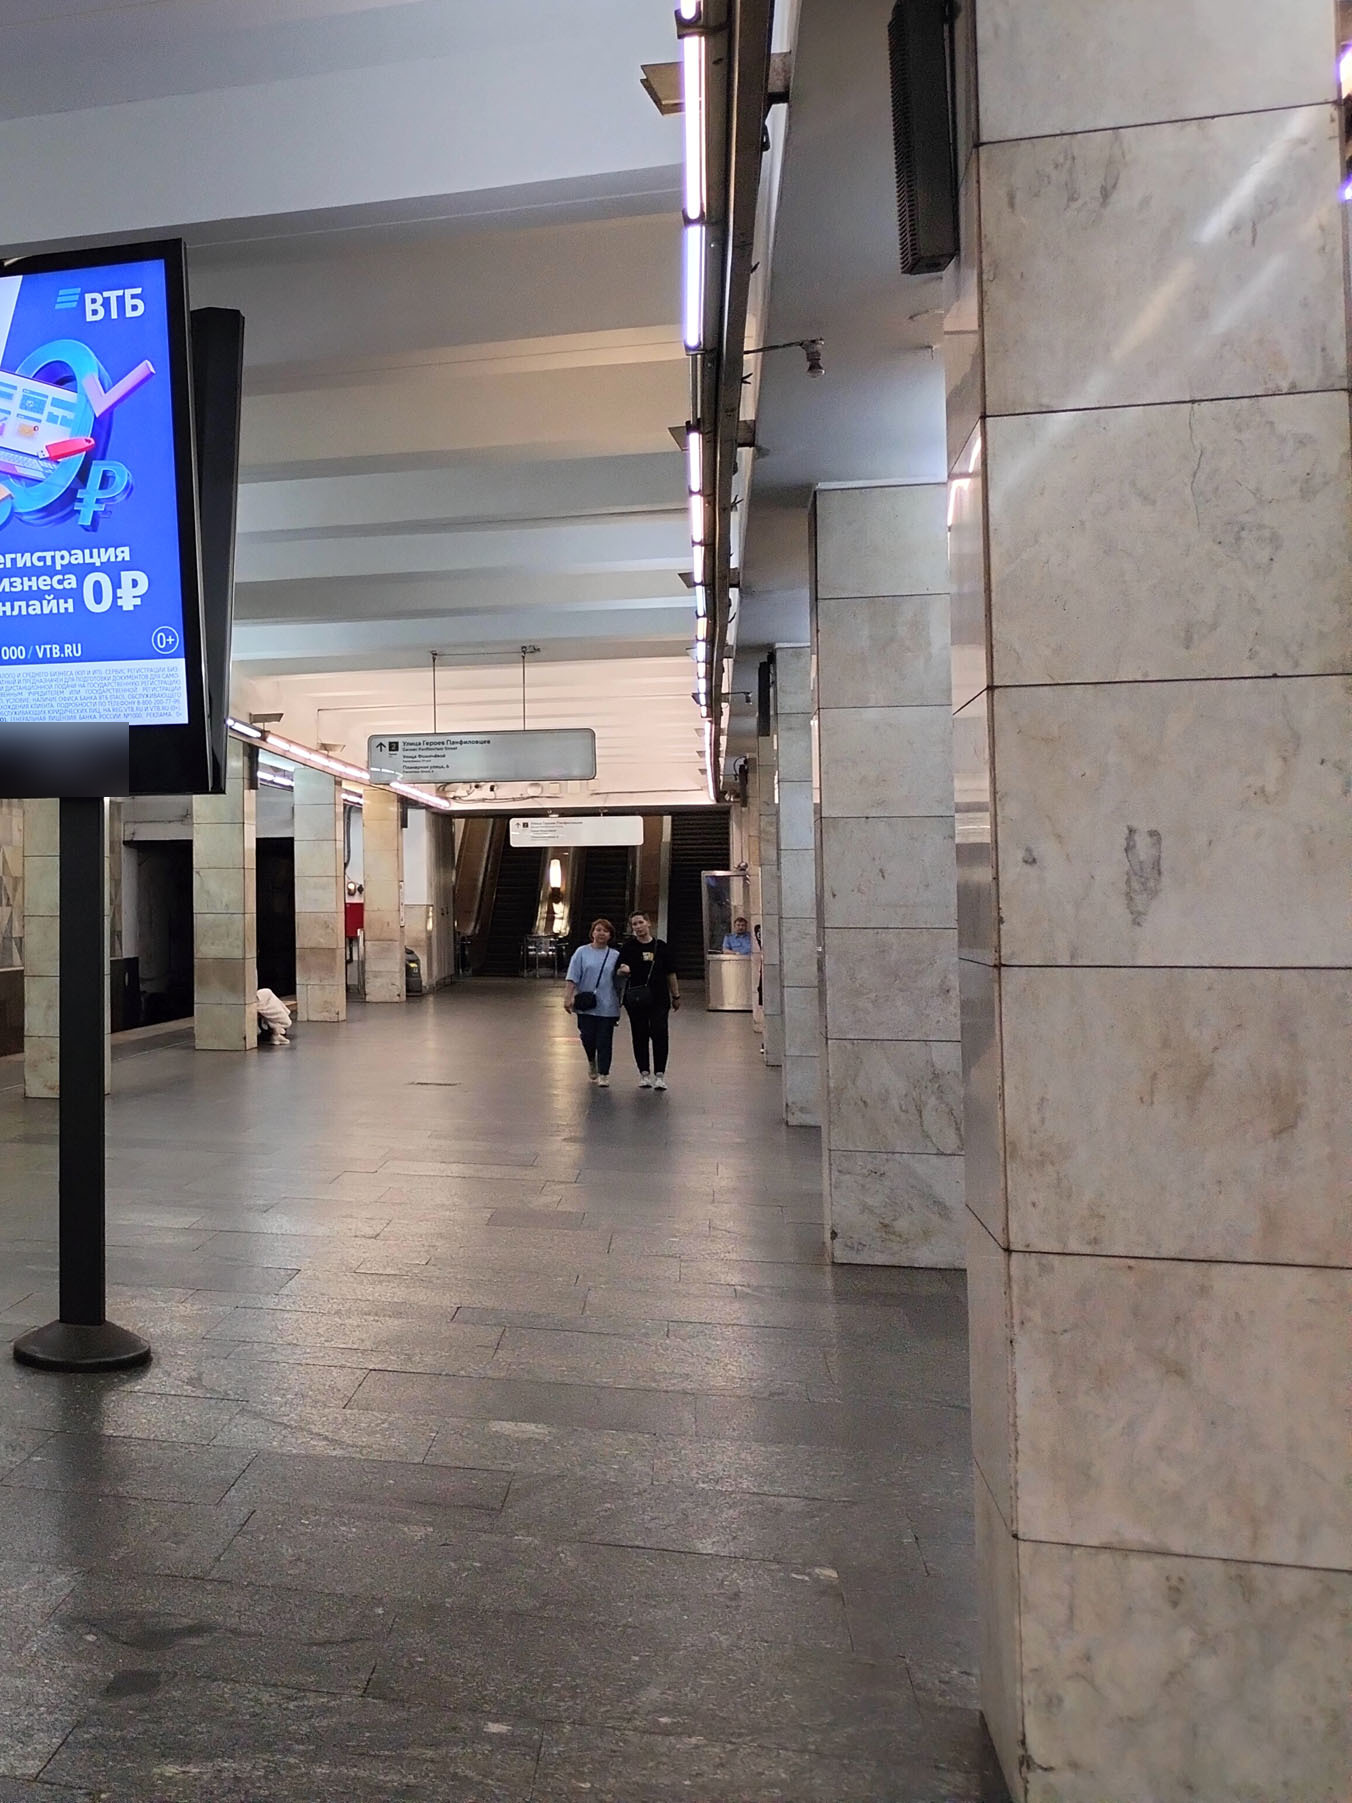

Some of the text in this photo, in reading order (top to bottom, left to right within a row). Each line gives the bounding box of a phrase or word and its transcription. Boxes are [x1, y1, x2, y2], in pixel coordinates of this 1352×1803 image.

[84, 287, 145, 322] ВТБ
[156, 632, 175, 649] 0+
[35, 643, 82, 659] VTB.RU
